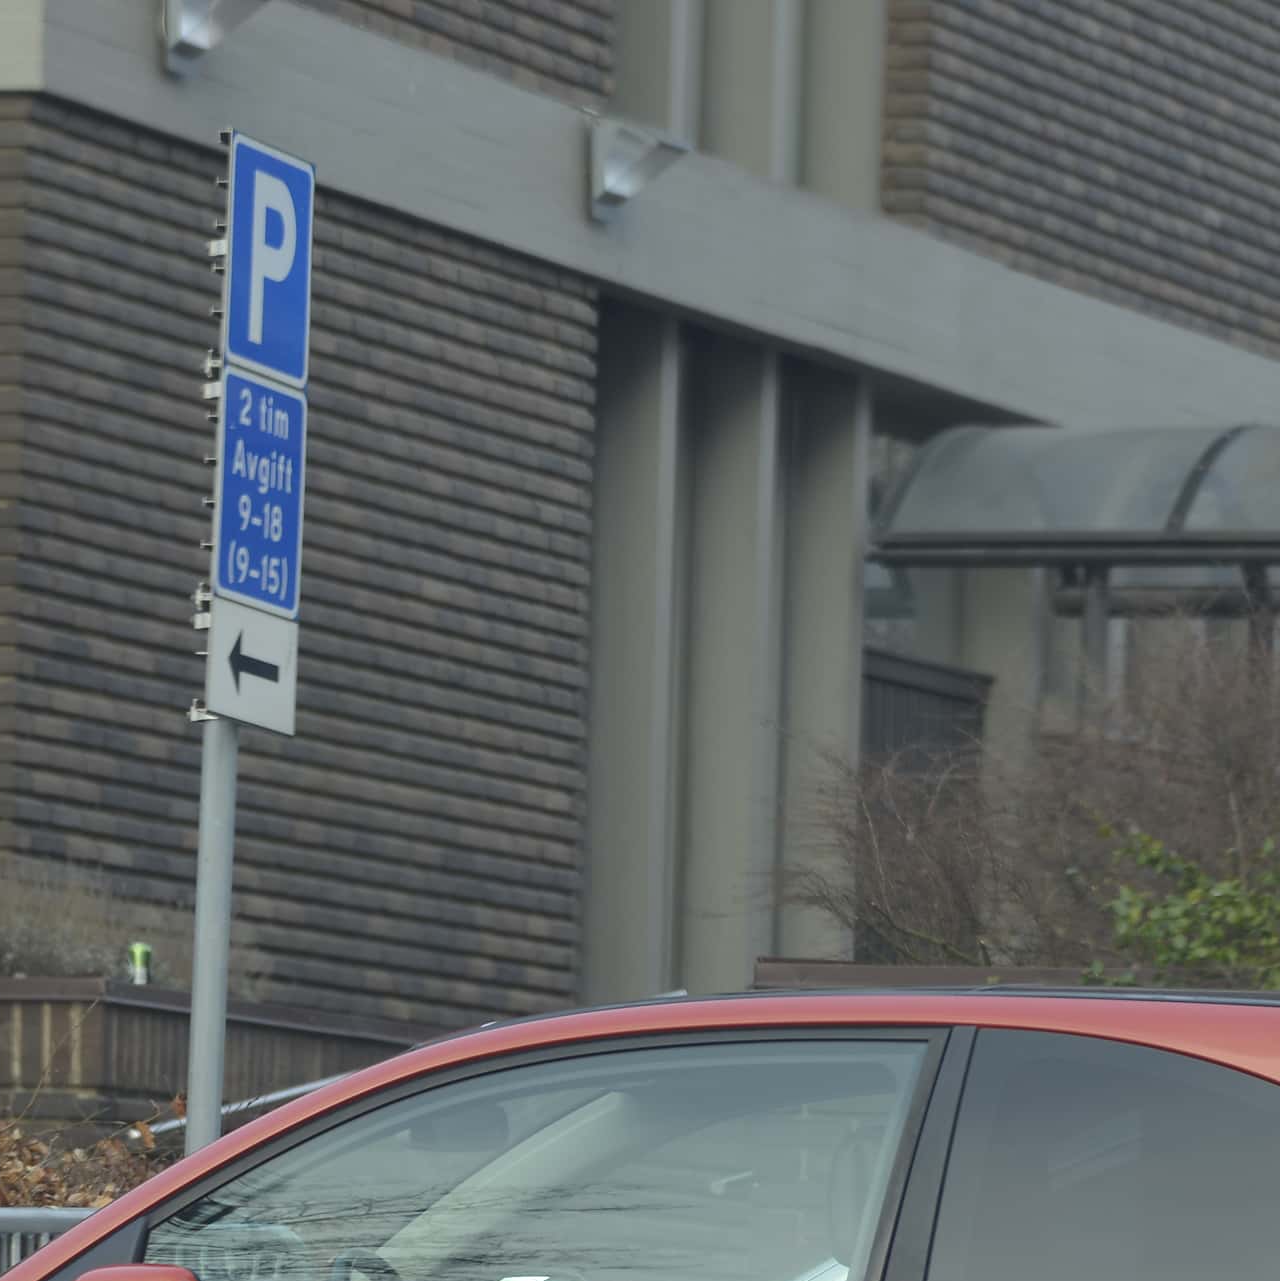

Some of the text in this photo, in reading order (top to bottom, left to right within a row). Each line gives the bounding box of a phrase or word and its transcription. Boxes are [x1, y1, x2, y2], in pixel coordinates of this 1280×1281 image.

[248, 169, 297, 345] P
[240, 388, 289, 440] 2 tim
[231, 438, 293, 494] Avgift
[238, 494, 282, 542] 9-18
[228, 540, 288, 601] (9-15)
